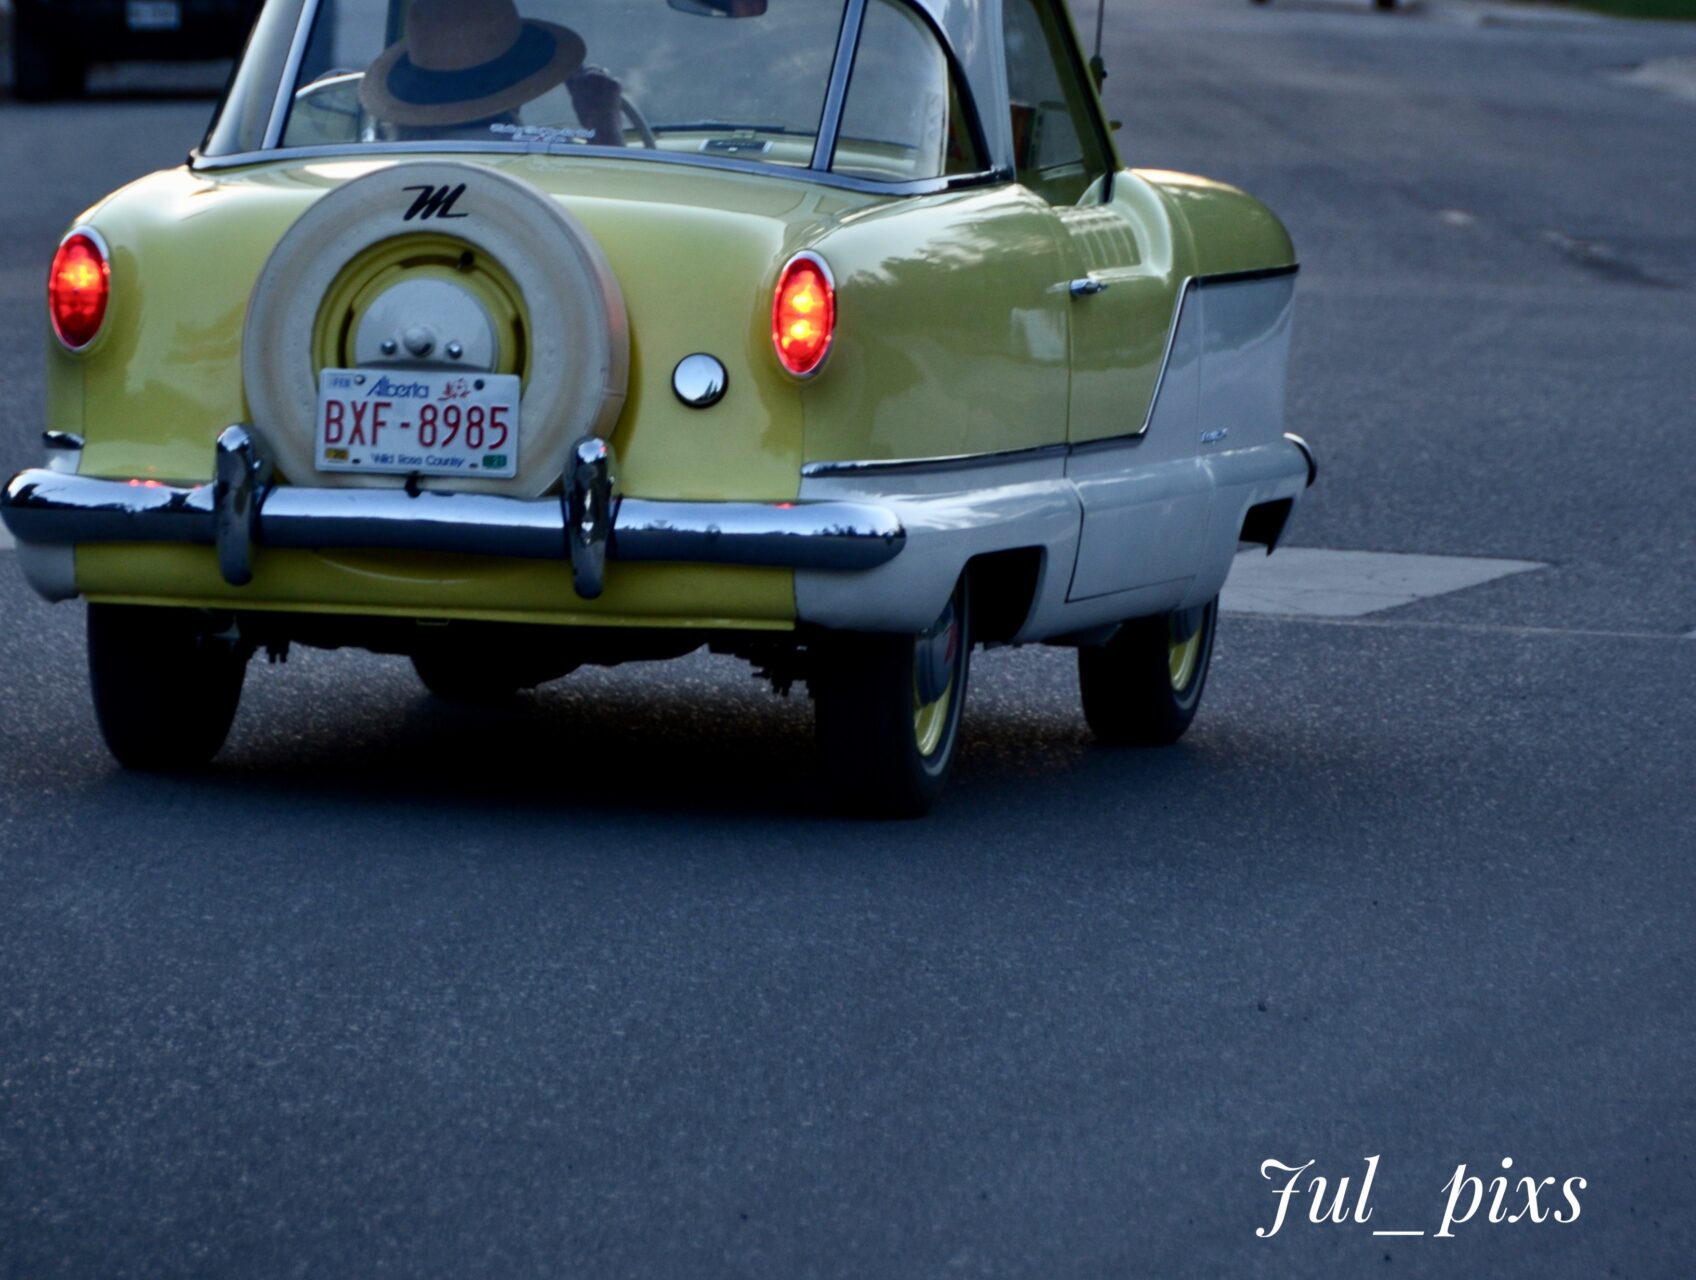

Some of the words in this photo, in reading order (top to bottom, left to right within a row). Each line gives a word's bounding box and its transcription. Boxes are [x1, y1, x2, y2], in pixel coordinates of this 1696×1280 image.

[366, 376, 430, 399] Alberta
[324, 399, 509, 450] BXF-8985
[370, 452, 394, 465] Wild
[425, 455, 465, 468] Country
